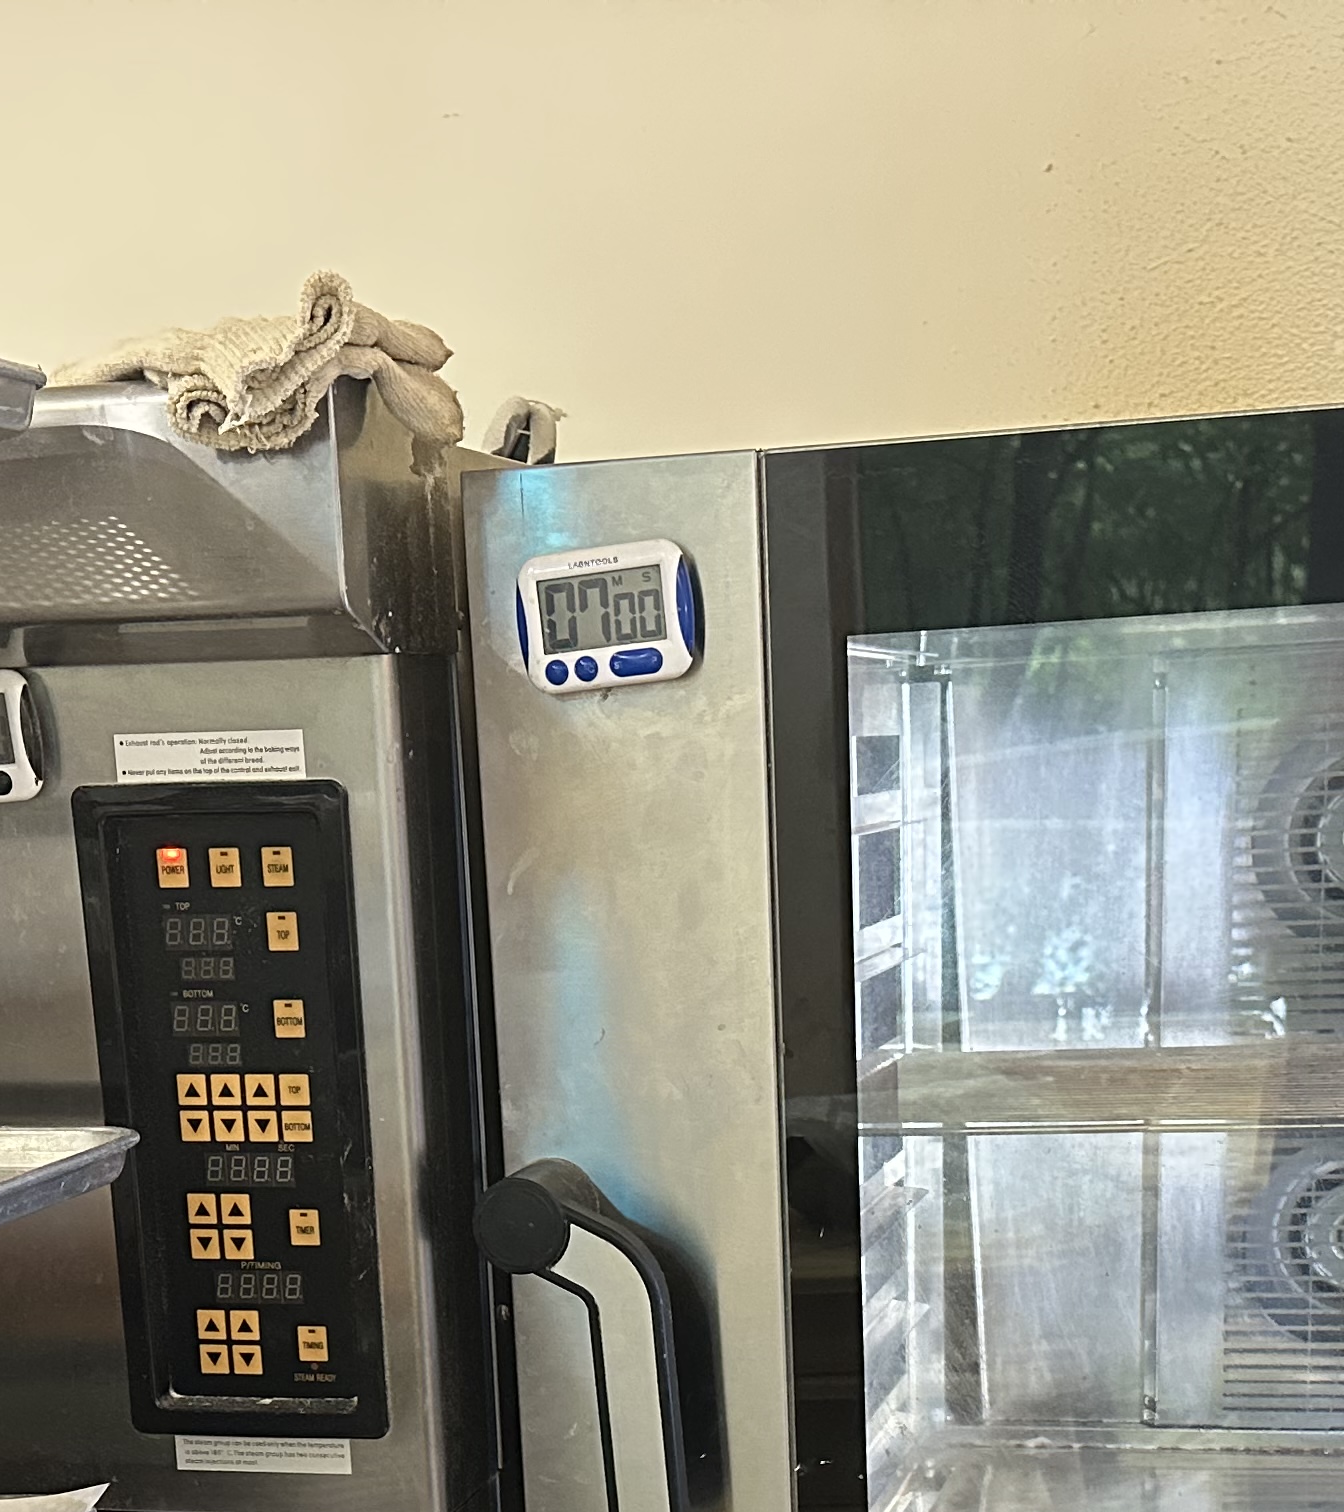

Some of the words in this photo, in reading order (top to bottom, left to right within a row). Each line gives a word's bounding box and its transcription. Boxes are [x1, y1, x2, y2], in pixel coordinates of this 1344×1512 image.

[641, 571, 652, 582] S
[161, 865, 185, 874] POWER
[216, 864, 235, 874] LIGHT
[267, 864, 289, 874] STEAM
[175, 902, 191, 910] TOP
[276, 930, 290, 940] TOP
[182, 989, 214, 999] BOTTOM
[276, 1016, 303, 1026] BOTTOM
[287, 1085, 301, 1095] TOP
[284, 1123, 311, 1132] BOTTOM
[225, 1143, 240, 1151] MIN
[277, 1143, 295, 1152] SEC
[296, 1225, 315, 1235] TIMER
[240, 1261, 282, 1270] P/TIMING
[302, 1341, 324, 1350] TIMING
[293, 1372, 315, 1382] STEAM
[316, 1373, 337, 1382] READY
